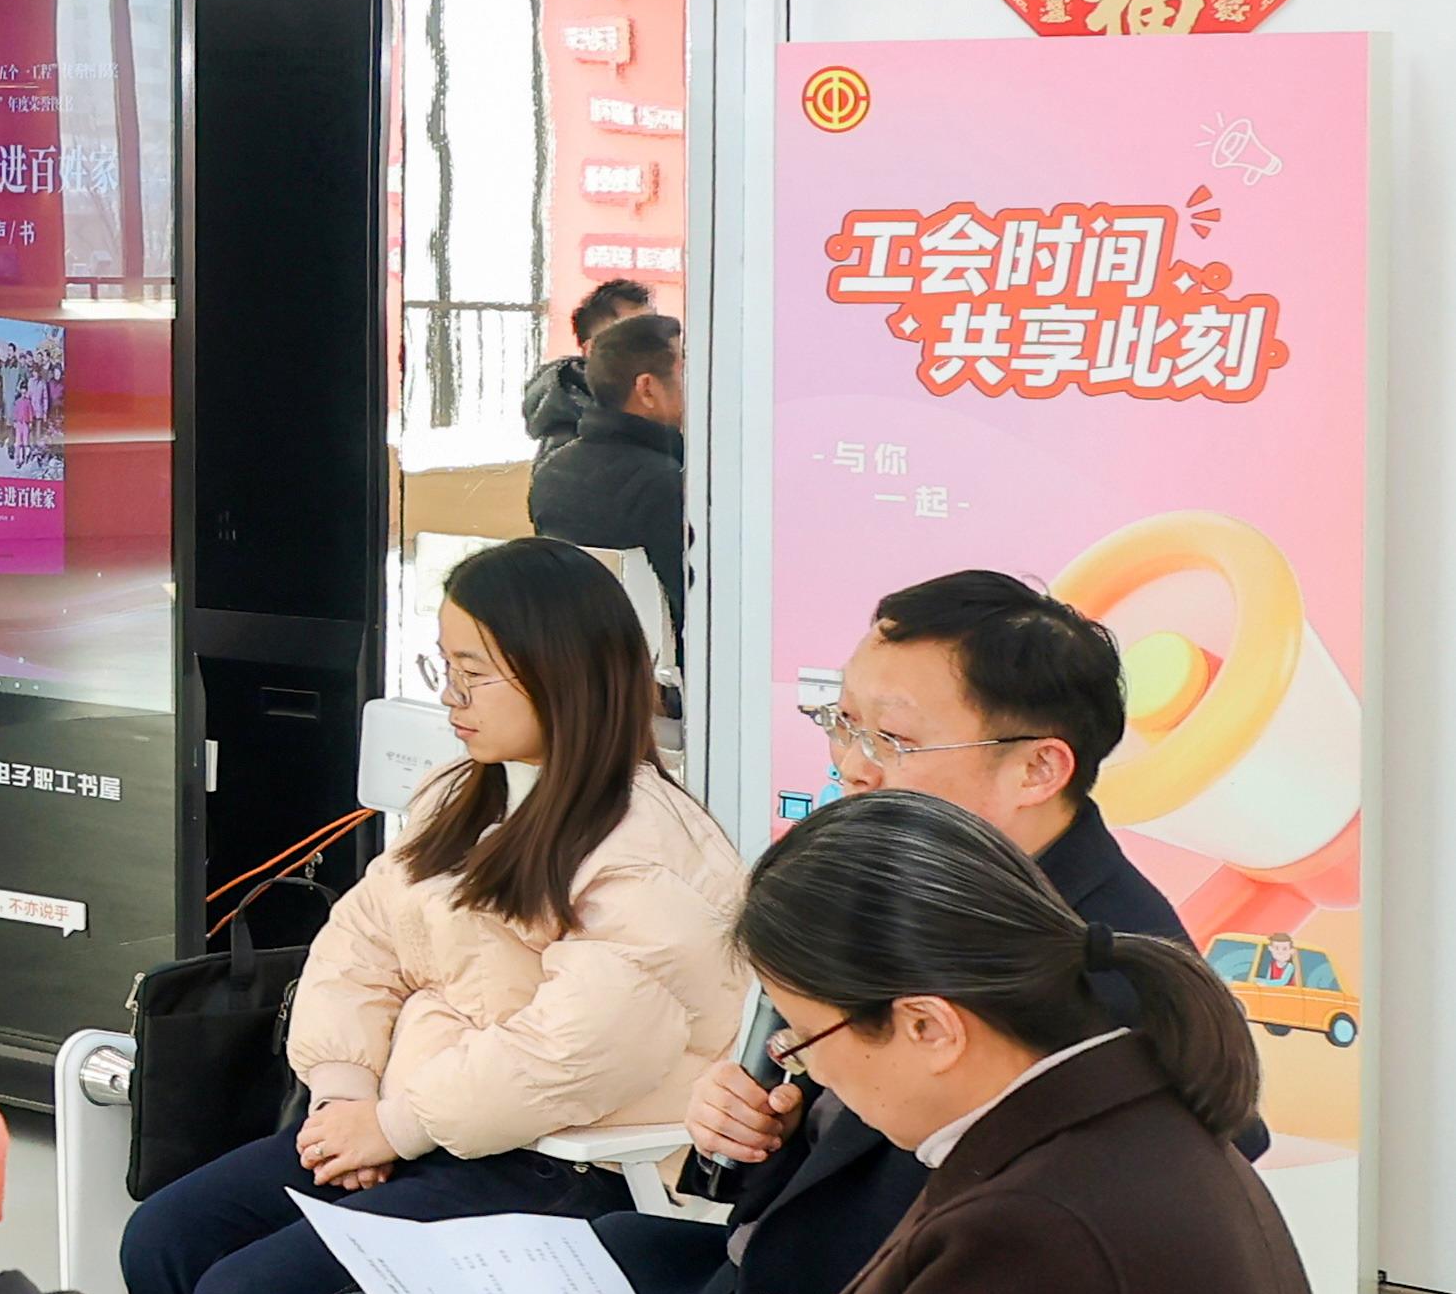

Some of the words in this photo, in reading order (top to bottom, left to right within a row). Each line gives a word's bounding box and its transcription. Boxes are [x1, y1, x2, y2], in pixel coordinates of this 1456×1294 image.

[839, 214, 1166, 298] 工会时间
[929, 303, 1267, 391] 共享此刻
